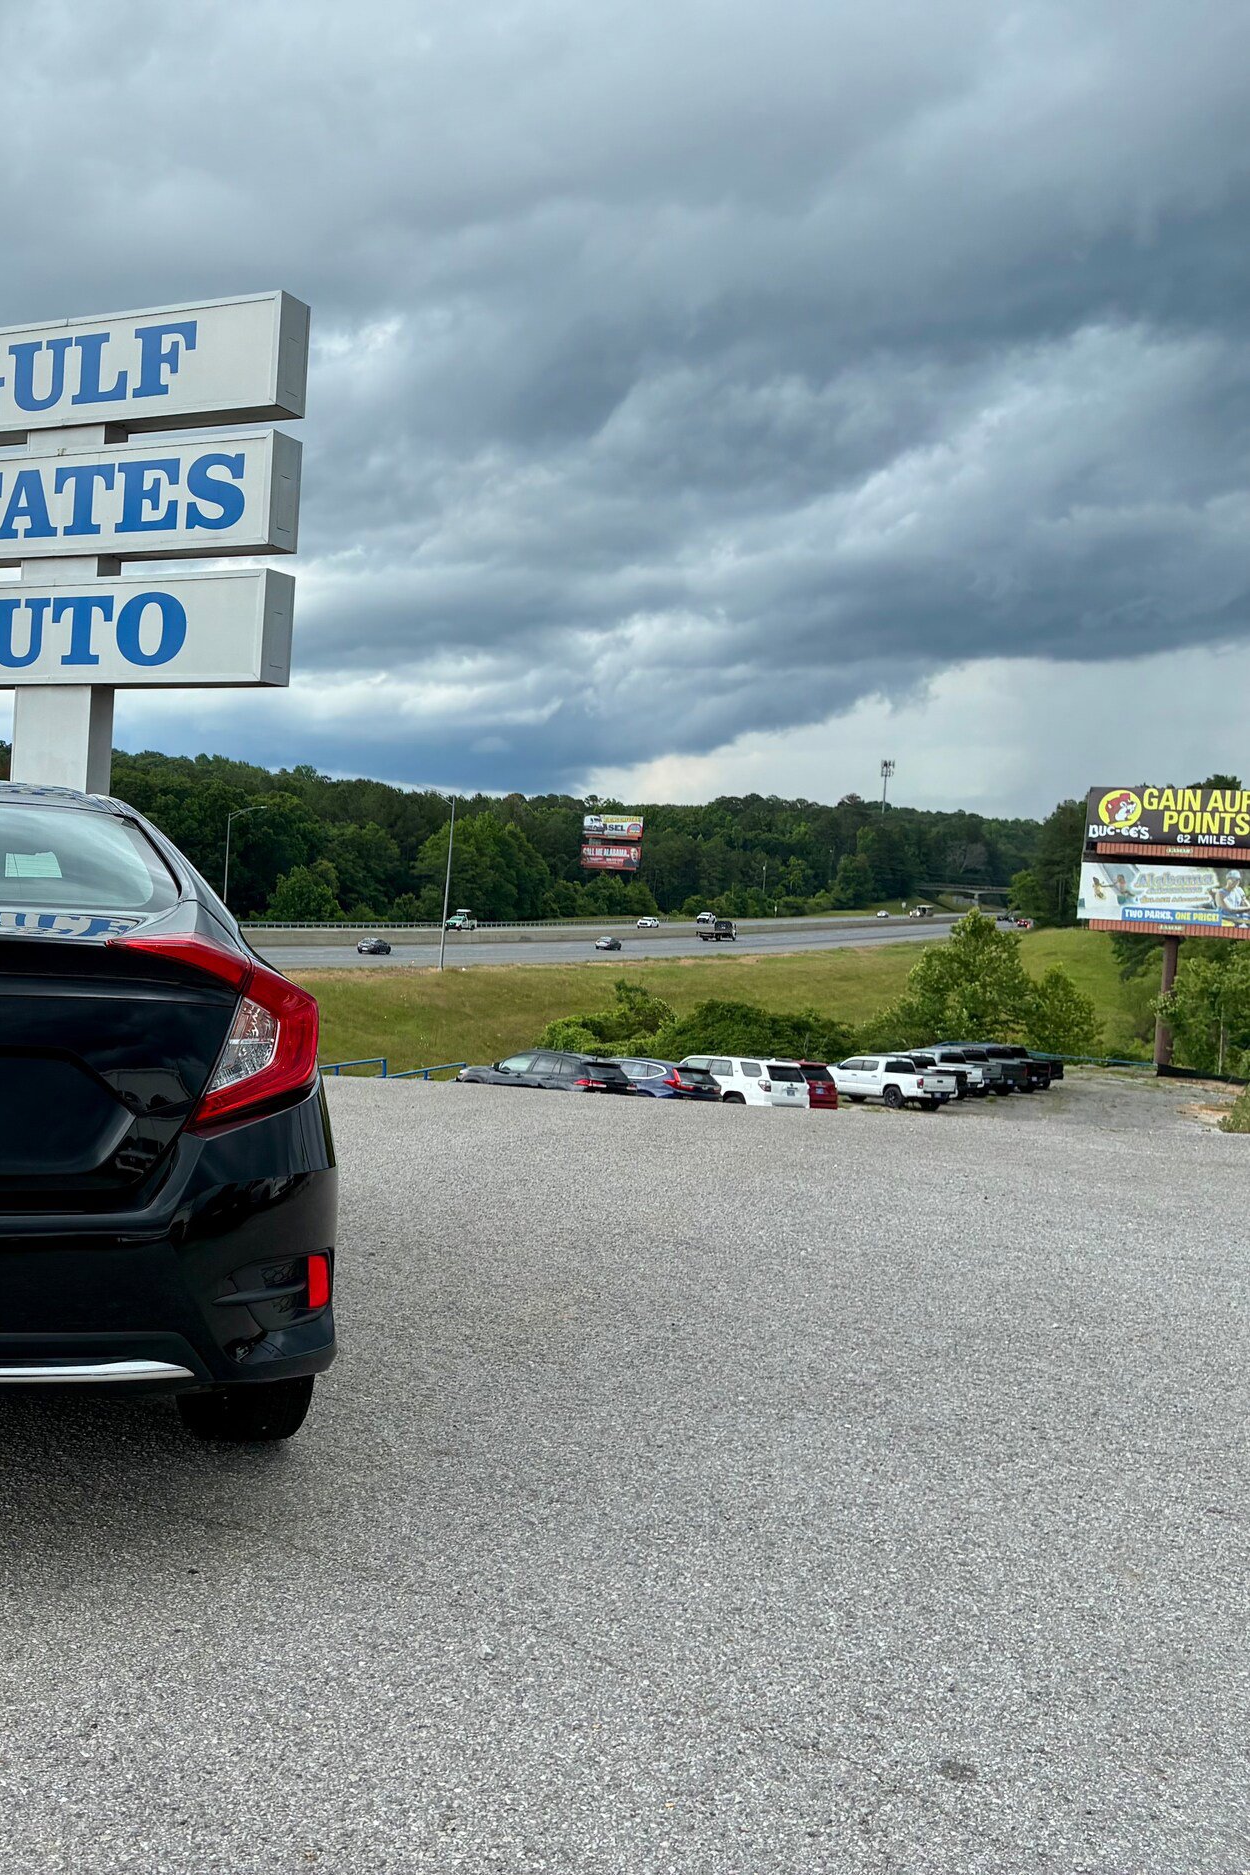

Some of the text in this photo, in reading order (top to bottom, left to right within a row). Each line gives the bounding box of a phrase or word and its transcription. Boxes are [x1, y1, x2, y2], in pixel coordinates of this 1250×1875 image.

[1143, 788, 1202, 811] GAIN
[1162, 810, 1250, 836] POINTS
[1176, 834, 1236, 846] 62 MILES
[1124, 908, 1144, 919] TWO
[1174, 912, 1192, 921] ONE
